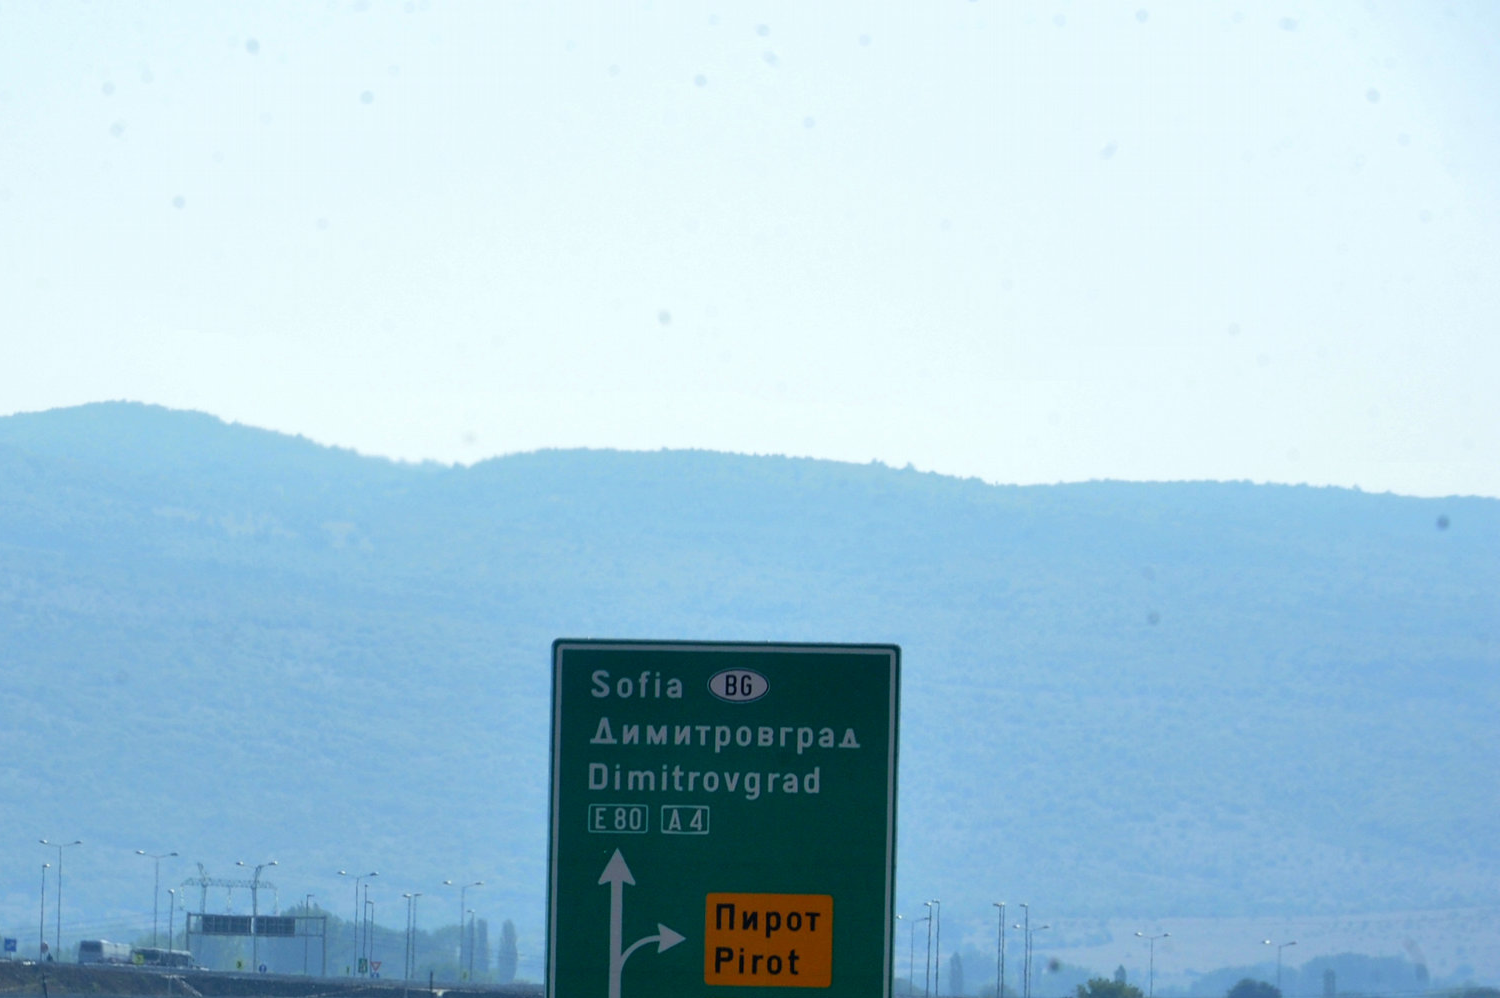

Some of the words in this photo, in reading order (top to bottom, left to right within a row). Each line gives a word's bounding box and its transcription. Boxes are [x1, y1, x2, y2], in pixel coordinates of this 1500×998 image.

[591, 670, 683, 699] Sofia
[725, 674, 753, 696] BG
[590, 718, 860, 754] Димитровград
[589, 763, 820, 800] Dimitrovgrad
[715, 904, 821, 937] Пирот
[714, 947, 800, 976] Pirot
